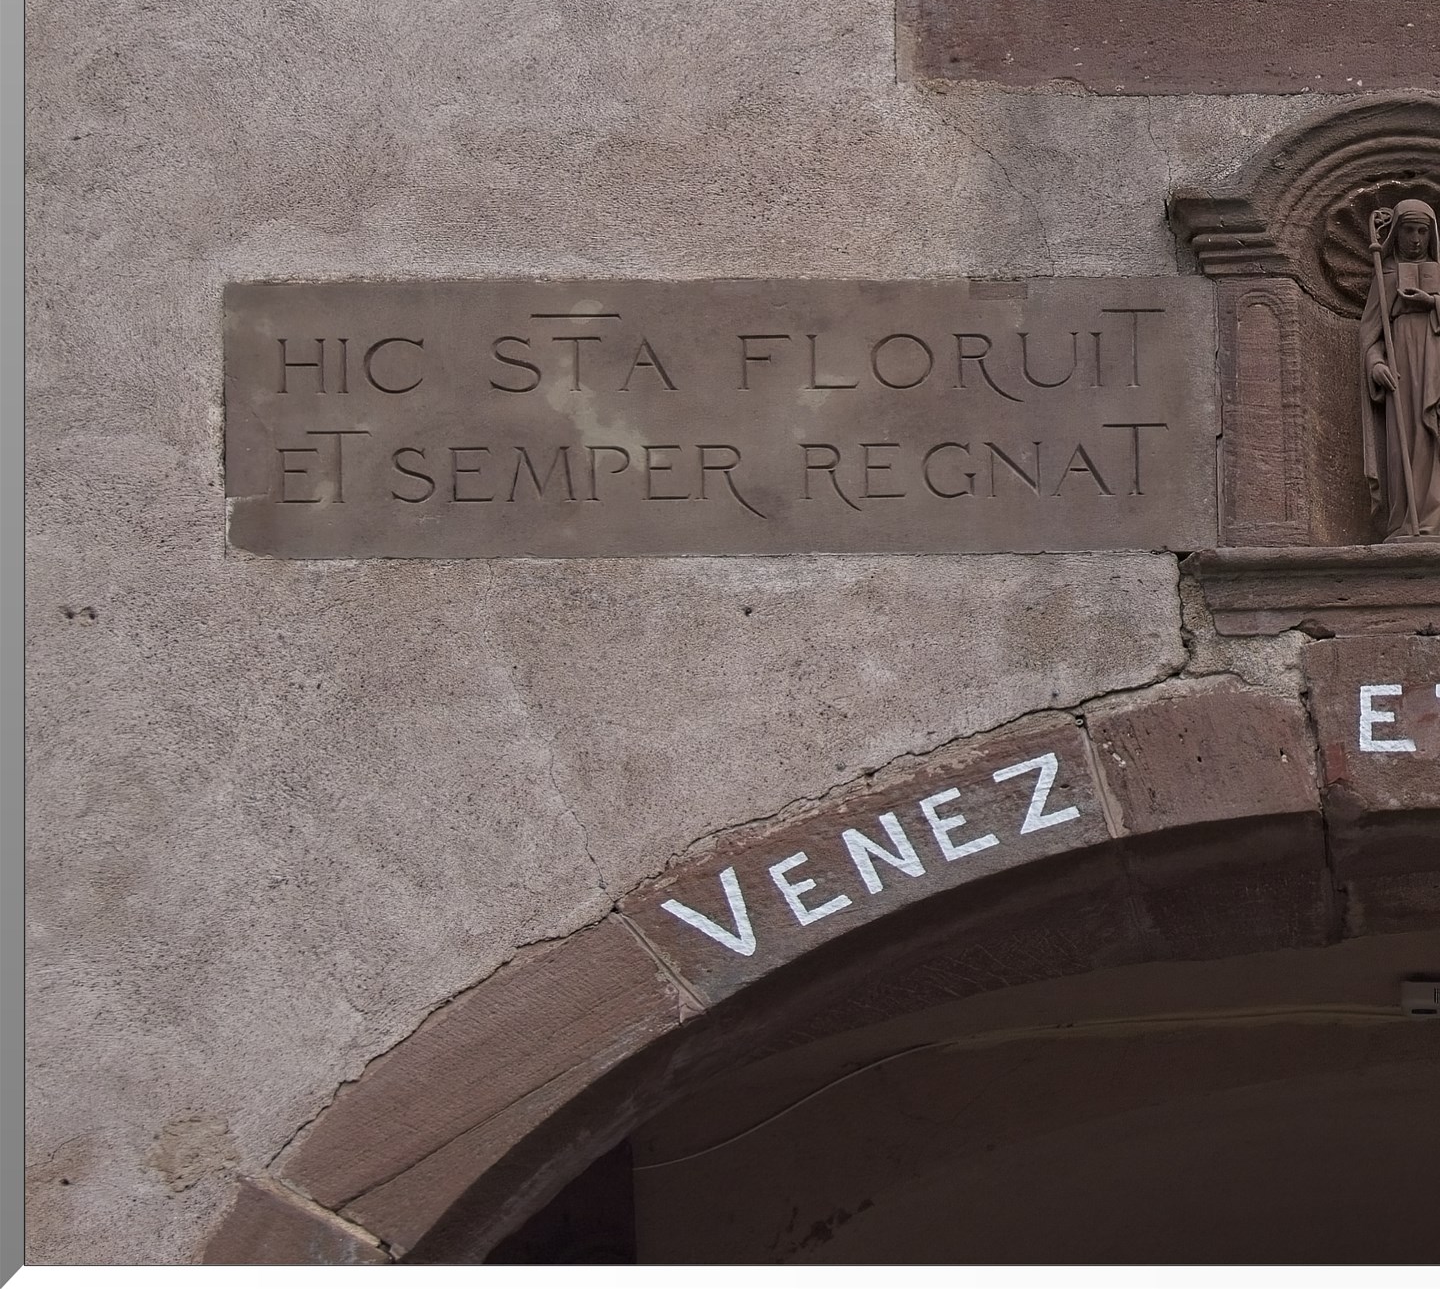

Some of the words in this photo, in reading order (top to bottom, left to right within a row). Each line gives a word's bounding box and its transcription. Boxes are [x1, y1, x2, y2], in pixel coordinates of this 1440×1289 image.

[276, 337, 424, 394] HIC
[737, 308, 1166, 402] FLORUIT
[275, 430, 373, 504] ET
[391, 444, 767, 520] SEMPER
[798, 422, 1169, 511] REGNAT
[660, 752, 1081, 957] VENEZ
